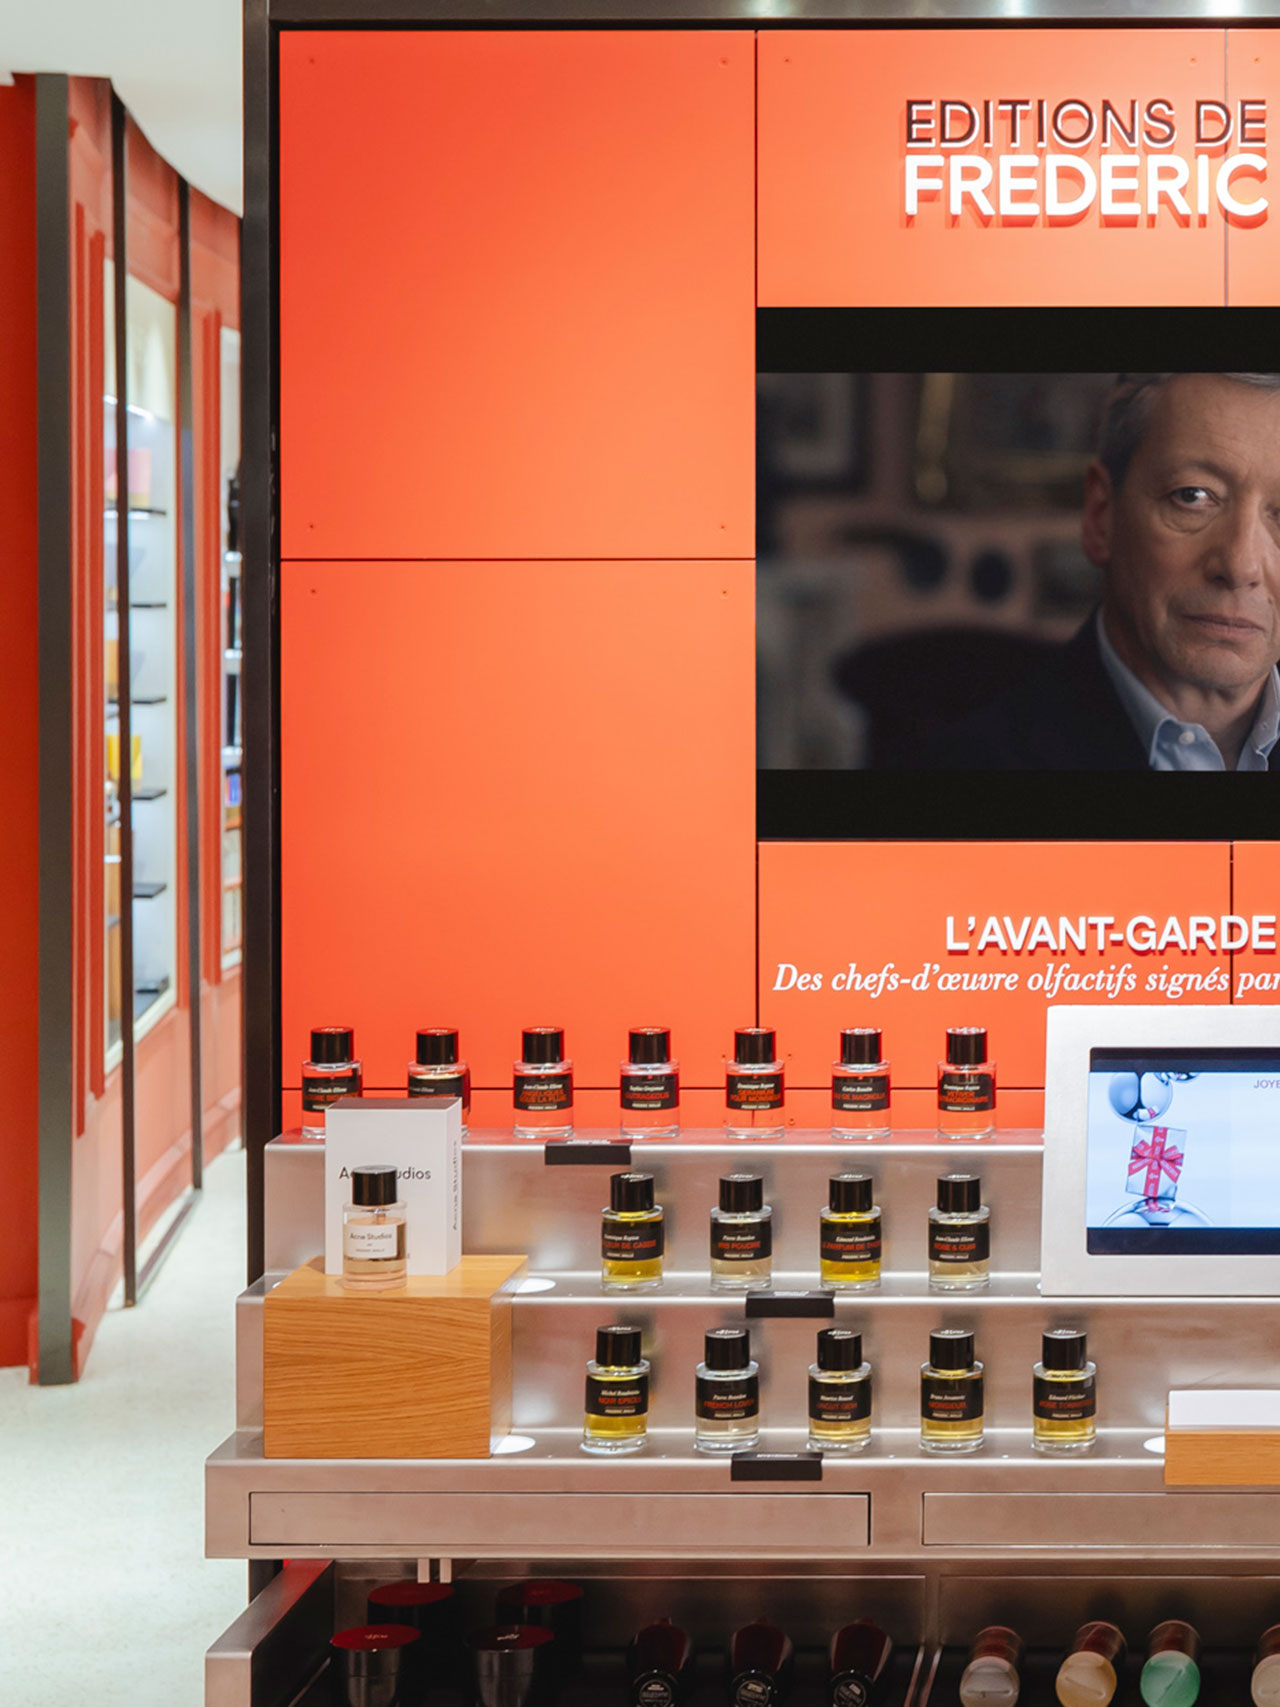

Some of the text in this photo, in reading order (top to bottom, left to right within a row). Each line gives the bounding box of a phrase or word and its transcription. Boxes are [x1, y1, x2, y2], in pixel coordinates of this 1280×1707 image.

[905, 99, 1177, 148] EDITIONS
[1195, 99, 1267, 148] DE
[904, 154, 1268, 217] FREDERIC
[946, 914, 1277, 951] L'AVANT-GARDE
[773, 963, 823, 991] Des
[1026, 962, 1137, 999] olfactifs
[1144, 964, 1230, 999] signés
